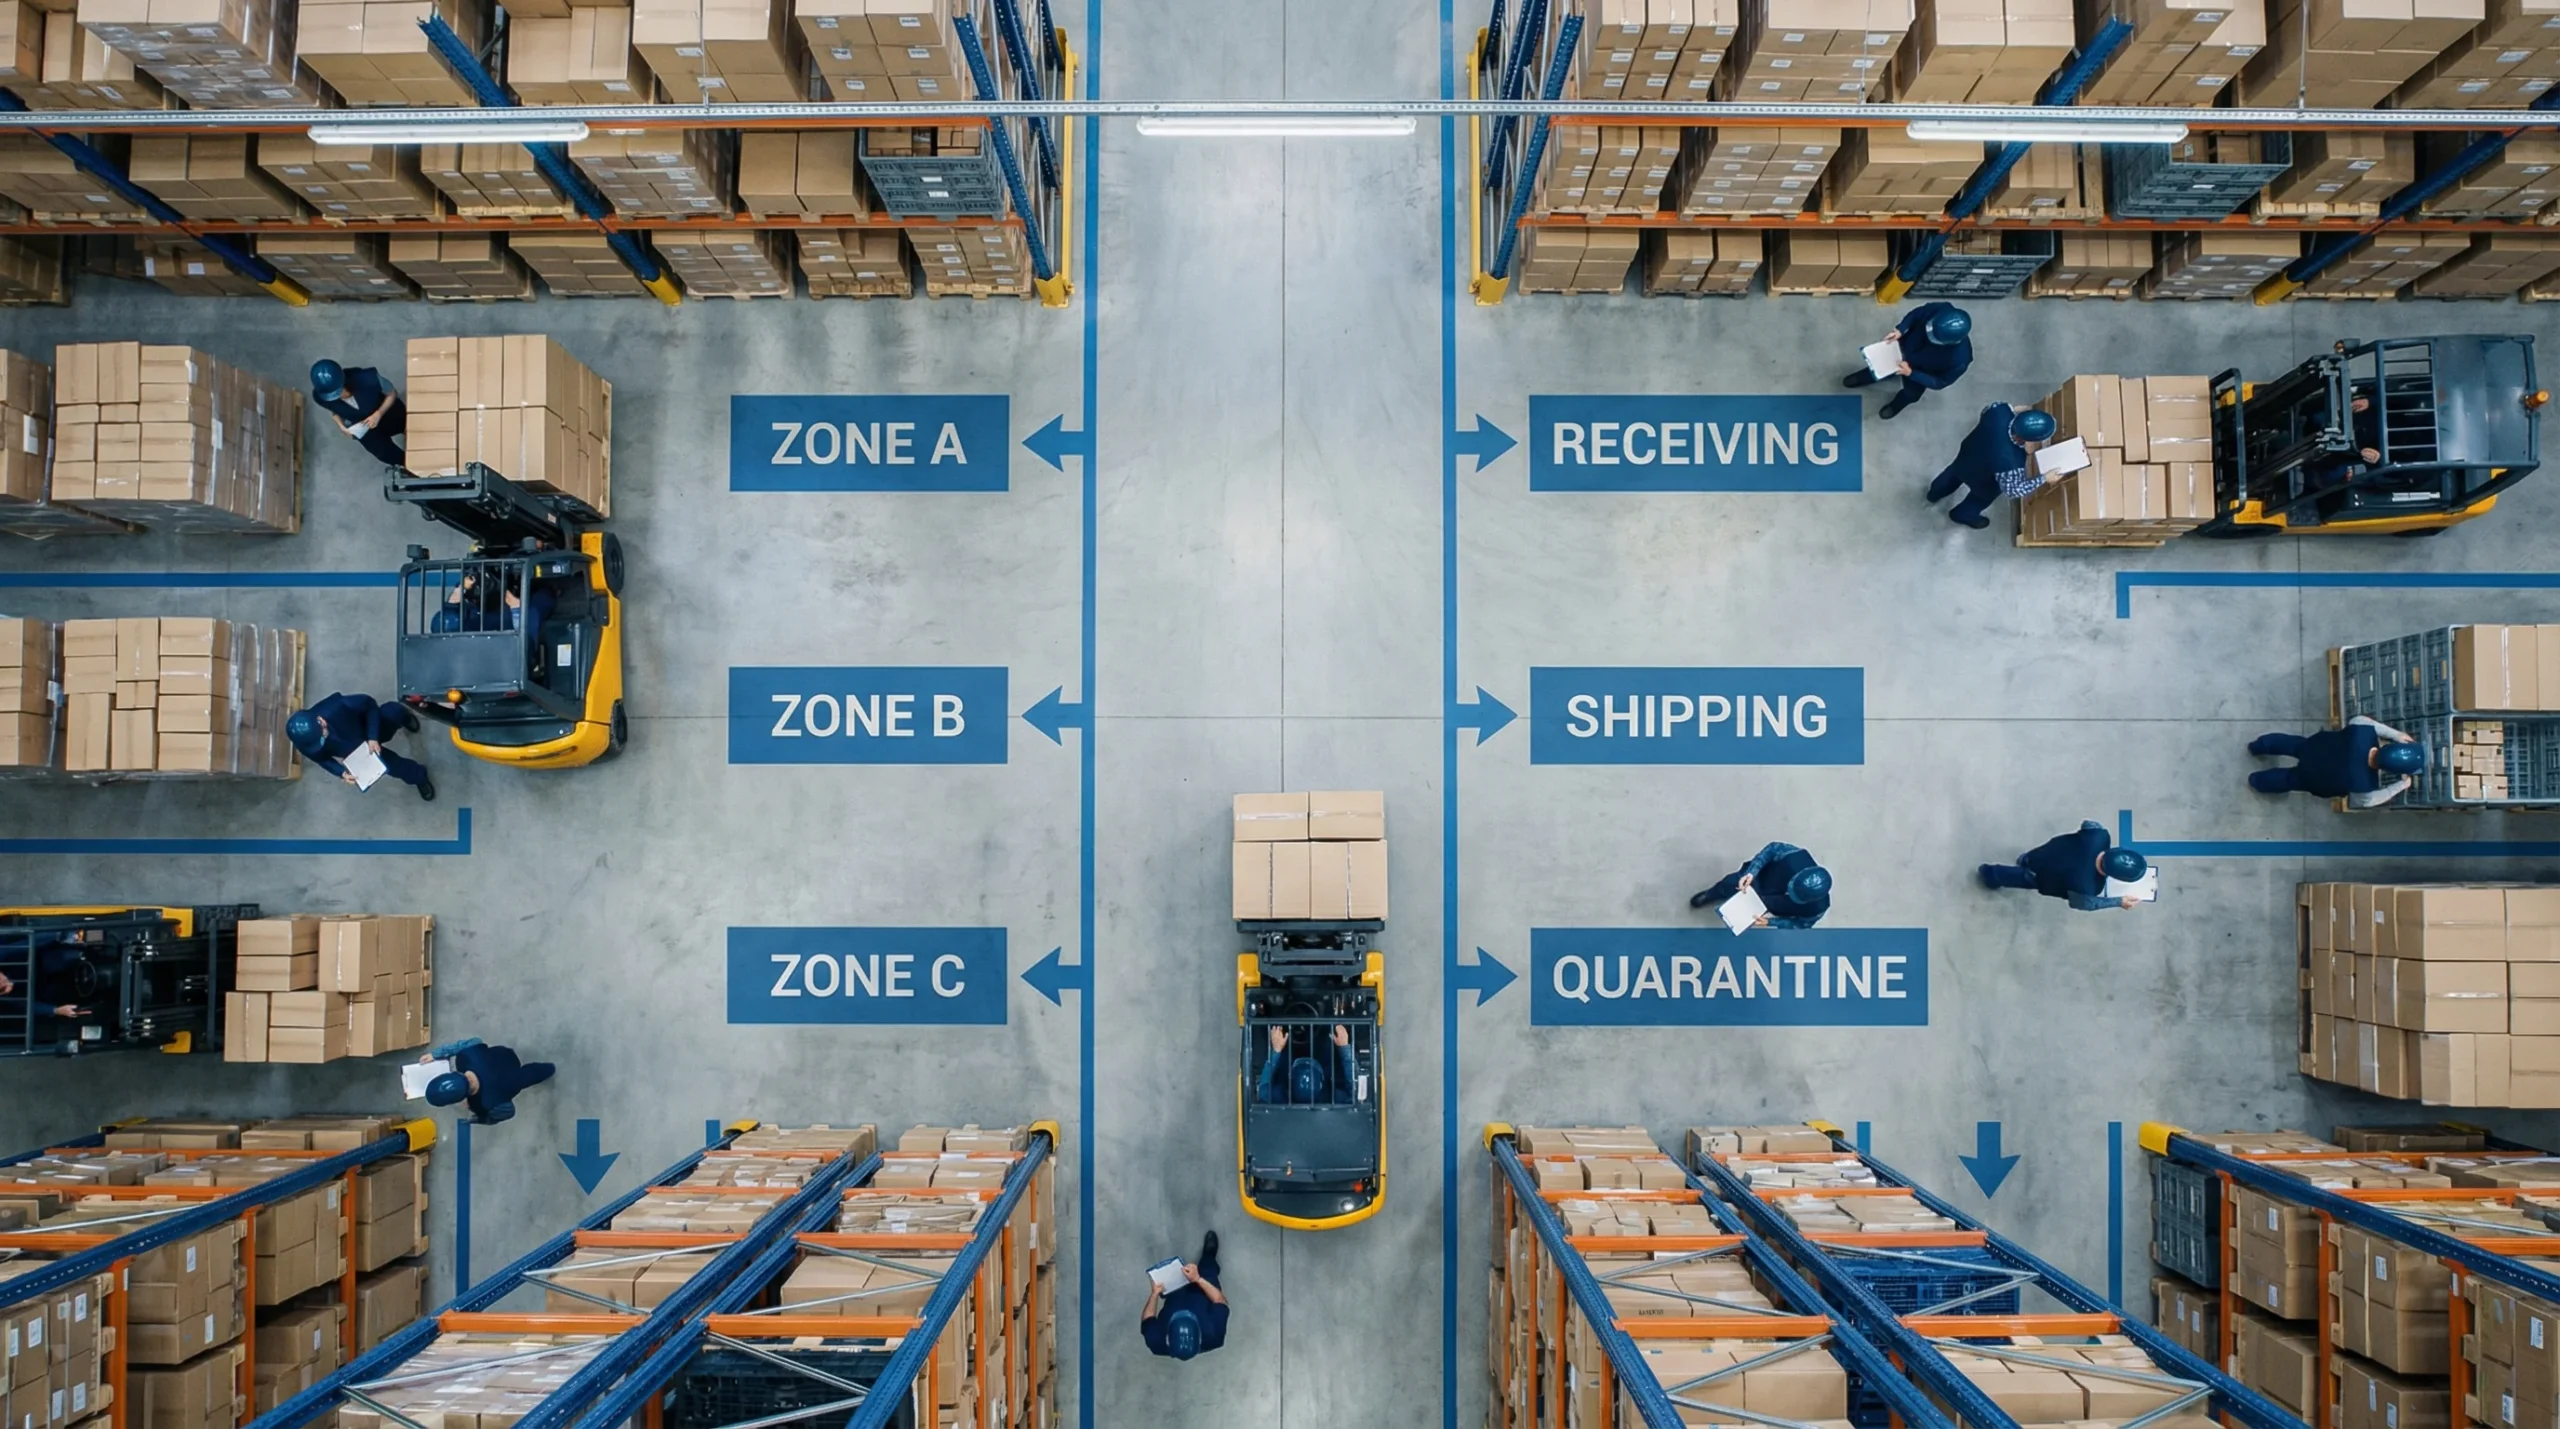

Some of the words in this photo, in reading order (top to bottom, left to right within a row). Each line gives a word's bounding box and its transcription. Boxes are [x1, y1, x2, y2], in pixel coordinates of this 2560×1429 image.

[771, 422, 915, 465] ZONE
[930, 422, 967, 465] A
[1554, 422, 1839, 465] RECEIVING
[771, 694, 915, 737] ZONE
[933, 694, 965, 737] B
[1566, 694, 1828, 738] SHIPPING
[770, 953, 914, 997] ZONE
[932, 953, 965, 997] C
[1553, 955, 1907, 1004] QUARANTINE
